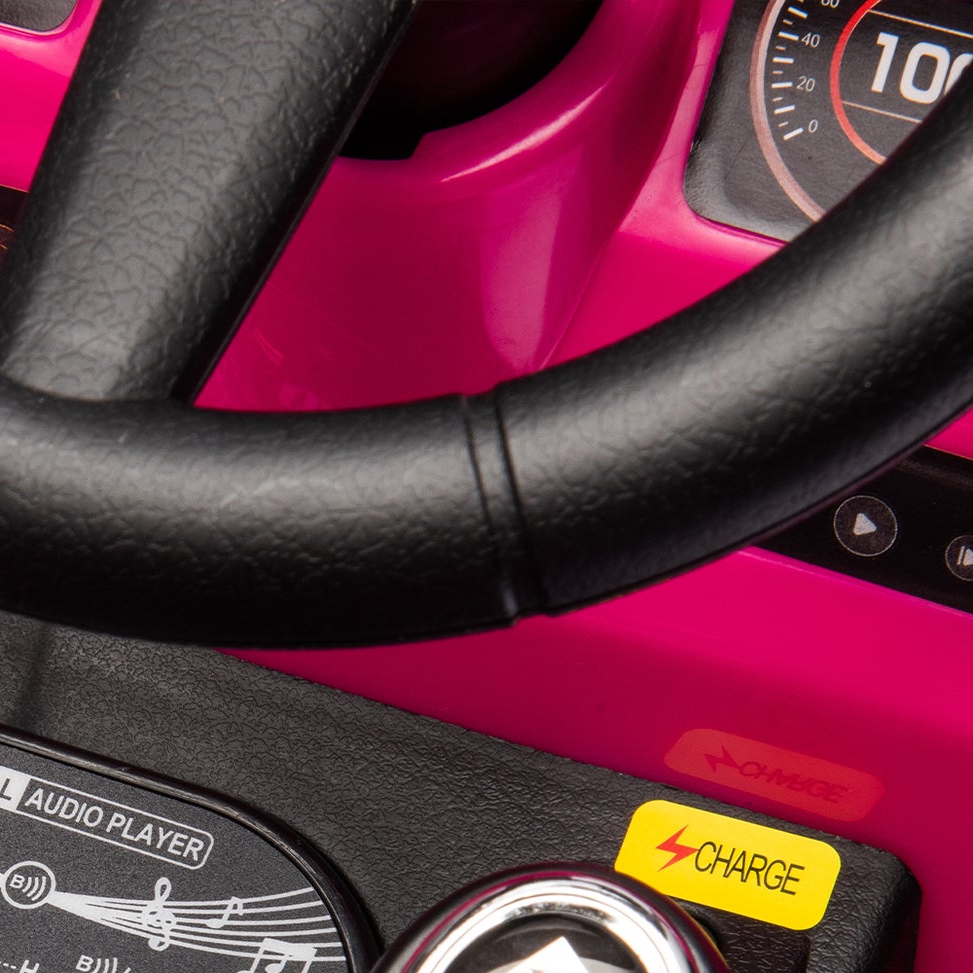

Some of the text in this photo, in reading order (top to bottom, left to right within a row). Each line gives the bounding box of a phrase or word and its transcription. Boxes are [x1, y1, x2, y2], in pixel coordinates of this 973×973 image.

[801, 32, 820, 48] 40
[796, 75, 815, 92] 20
[808, 119, 818, 132] 0
[24, 787, 104, 827] AUDIO
[106, 812, 205, 862] PLAYER
[694, 841, 805, 896] CHARGE
